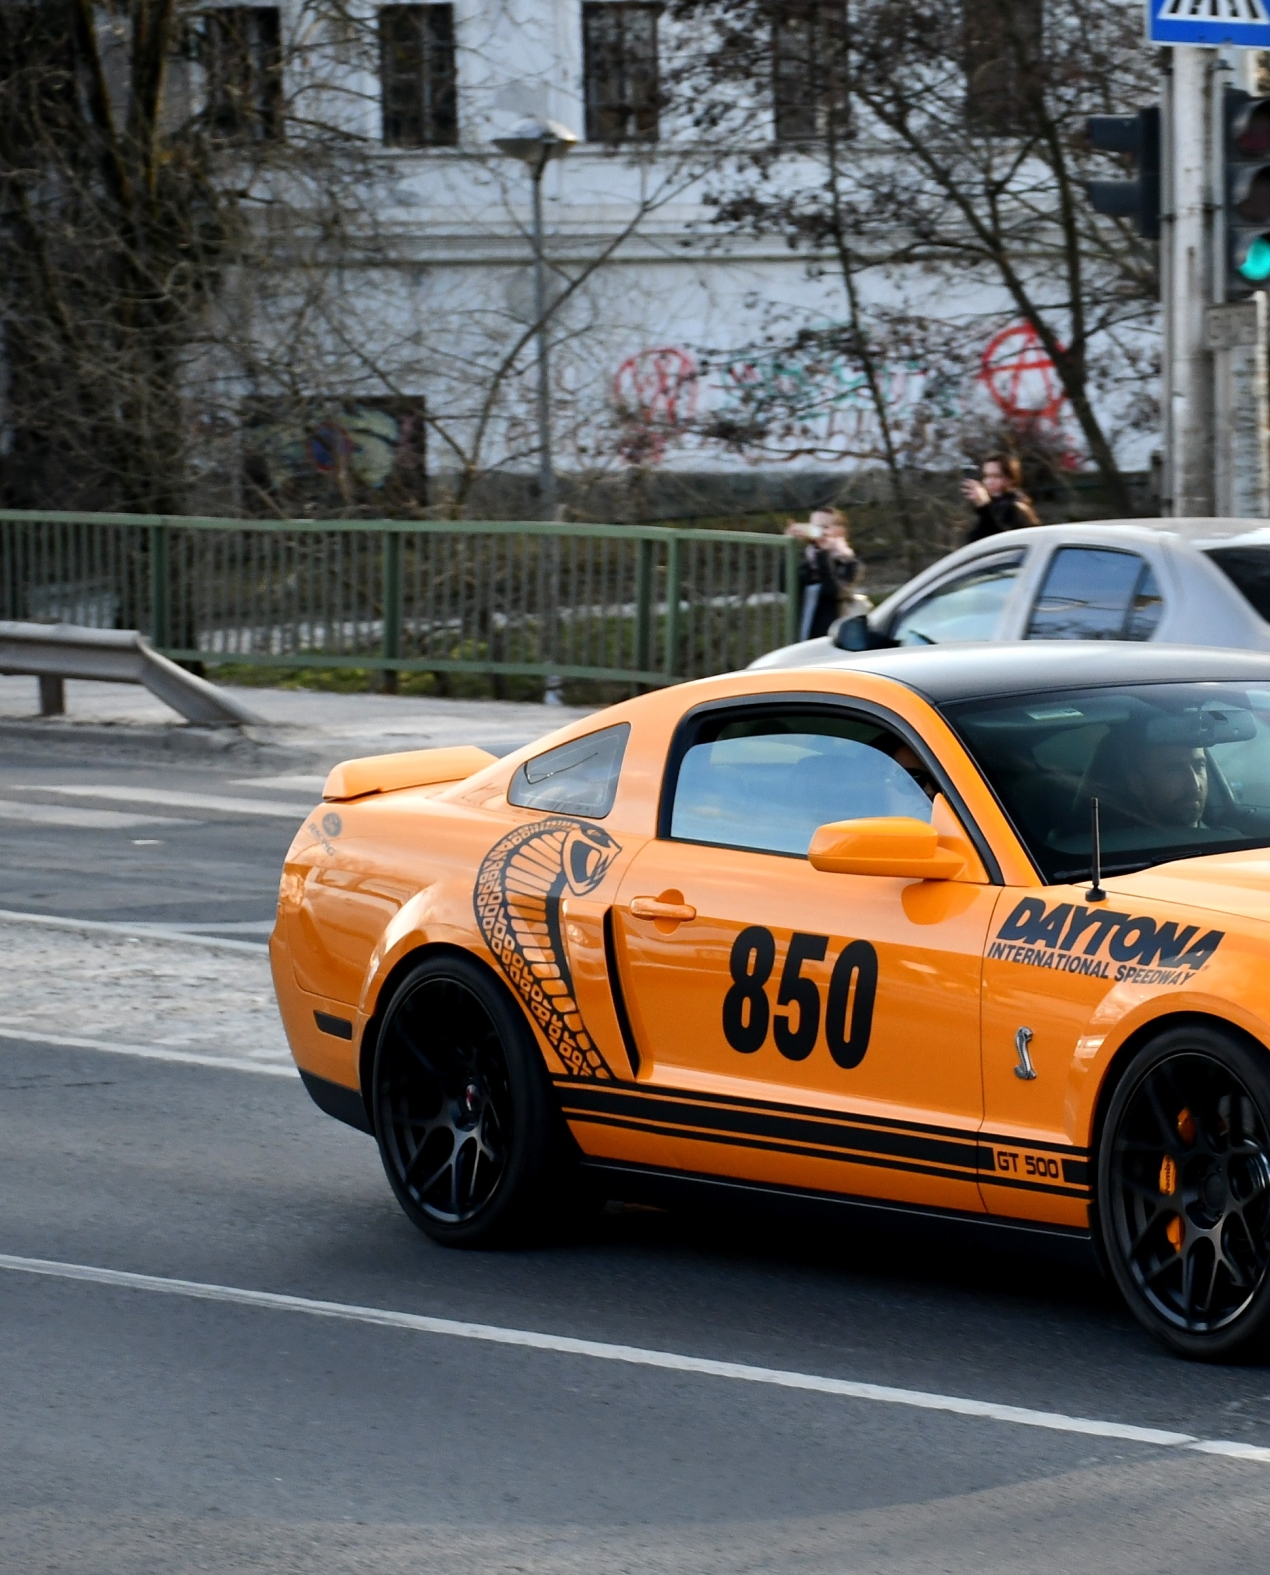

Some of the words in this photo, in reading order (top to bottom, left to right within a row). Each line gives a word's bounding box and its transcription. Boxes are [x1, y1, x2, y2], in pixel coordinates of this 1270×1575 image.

[996, 896, 1225, 970] DAYTONA
[987, 942, 1109, 979] INTERNATIONAL
[1114, 964, 1195, 985] SPEEDWAY
[722, 925, 878, 1069] 850
[997, 1150, 1019, 1173] GT
[1025, 1154, 1059, 1179] 500
